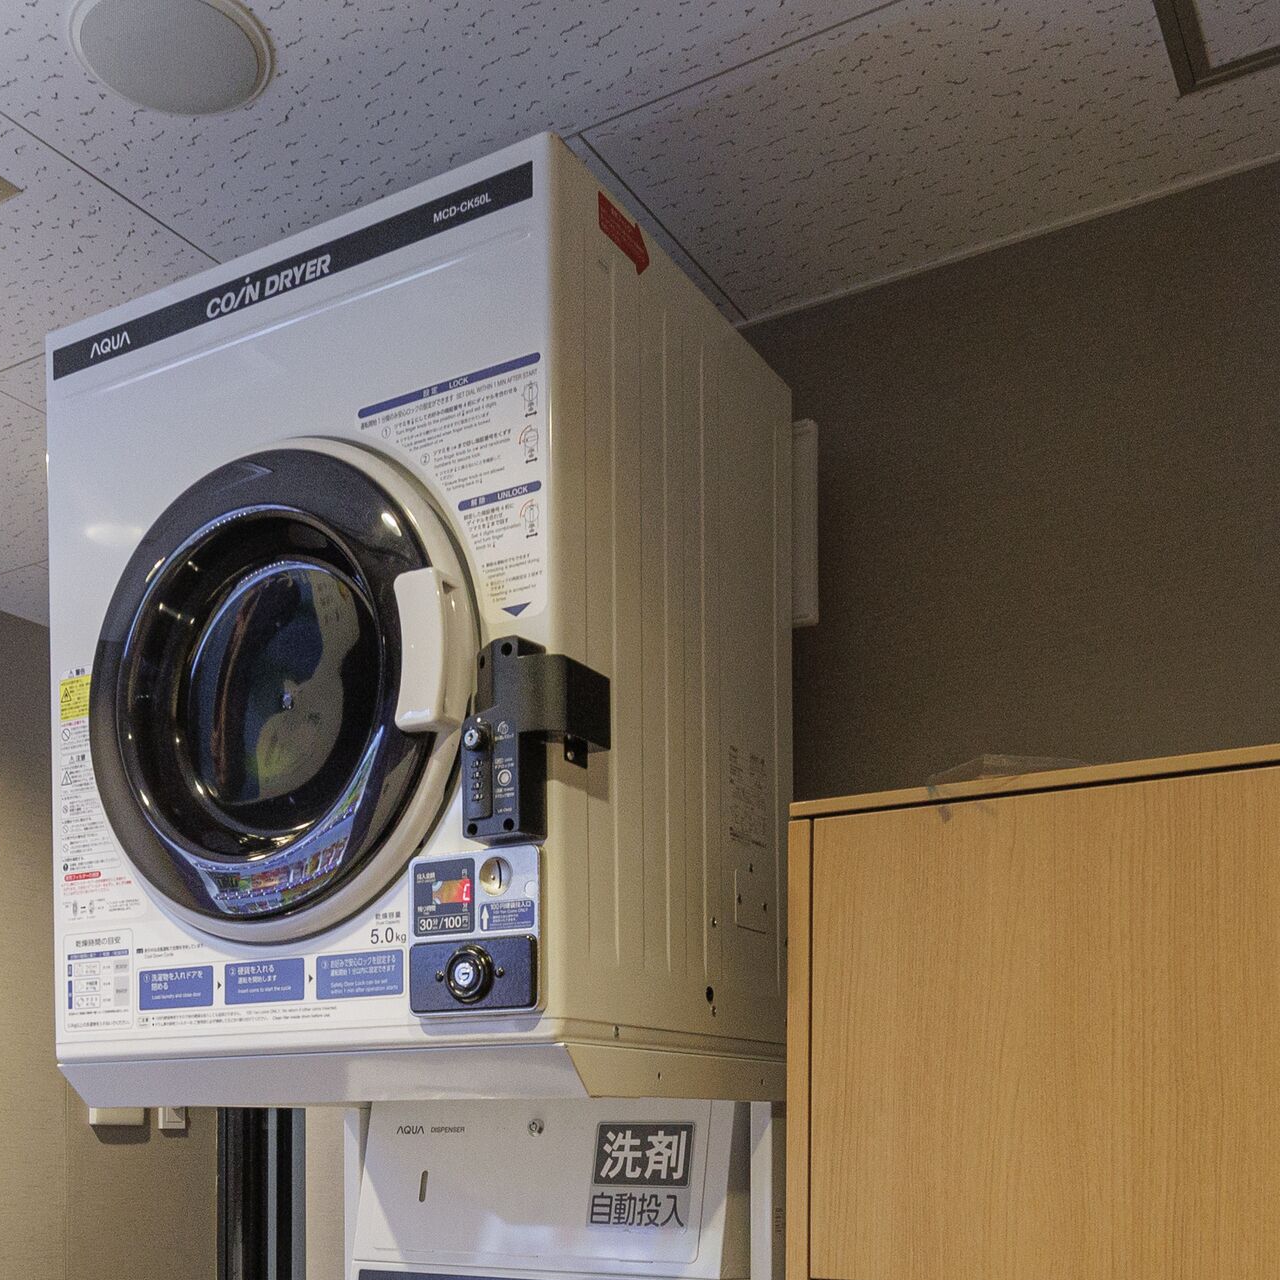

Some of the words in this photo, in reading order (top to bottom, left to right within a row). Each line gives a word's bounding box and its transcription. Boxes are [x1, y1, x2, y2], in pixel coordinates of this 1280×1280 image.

[433, 191, 492, 224] MCD-CK50L
[206, 277, 260, 318] COIN
[265, 254, 331, 298] DRYER
[90, 330, 131, 359] AQUA
[448, 375, 469, 390] LOCK
[497, 485, 527, 500] UNLOCK
[396, 1125, 425, 1135] AQUA
[430, 1126, 465, 1134] DISPENSER
[600, 1129, 688, 1180] 洗剤
[589, 1191, 685, 1228] 自動投入
